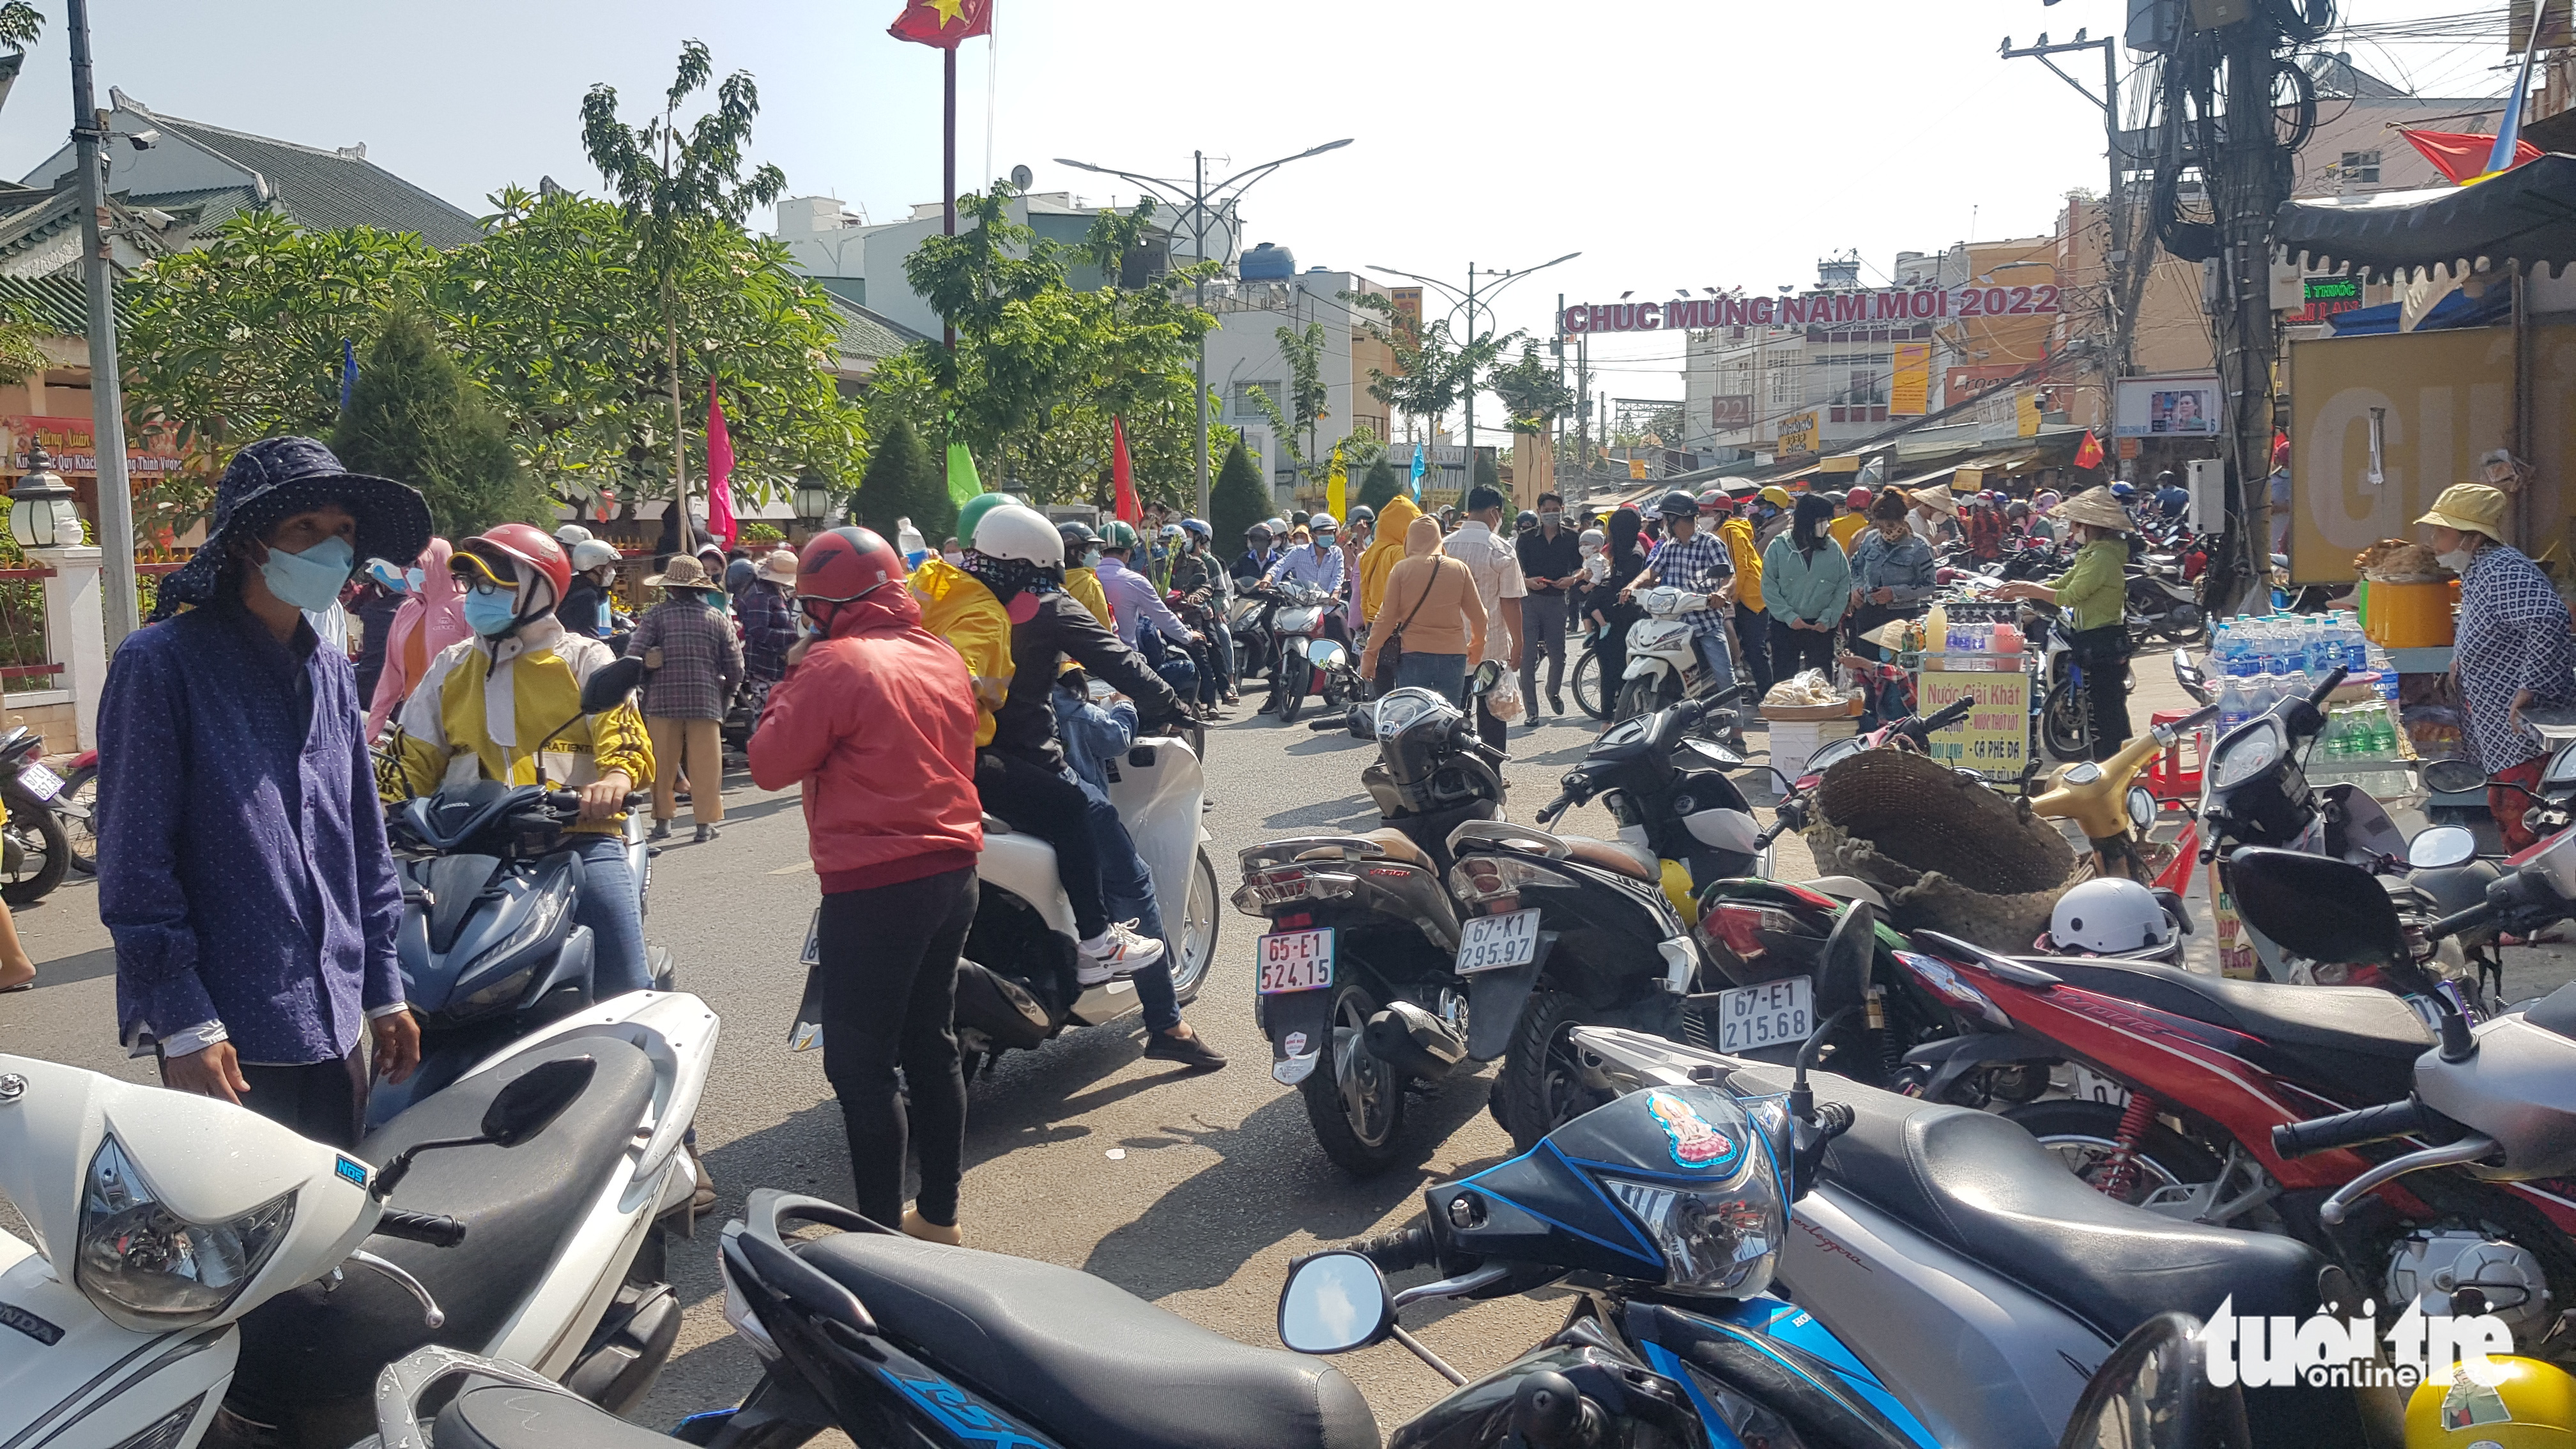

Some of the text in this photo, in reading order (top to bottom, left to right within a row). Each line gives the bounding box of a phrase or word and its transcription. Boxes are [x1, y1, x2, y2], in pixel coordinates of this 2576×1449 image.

[1958, 284, 2061, 318] 2022
[2314, 280, 2356, 298] THUỐC
[1714, 400, 1745, 423] 22
[1784, 433, 1807, 445] 9999
[1928, 683, 1959, 705] Nước
[1991, 684, 2021, 705] Khát
[1974, 737, 2020, 760] CÀ PHÊ ĐÁ
[1473, 914, 1525, 943] 67-K1
[1269, 933, 1320, 962] 65-E1
[1460, 937, 1530, 969] 295.97
[1261, 958, 1329, 990] 524.15
[1734, 982, 1793, 1016] 67-E1
[1726, 1009, 1805, 1048] 215.68
[337, 1159, 366, 1183] NOS
